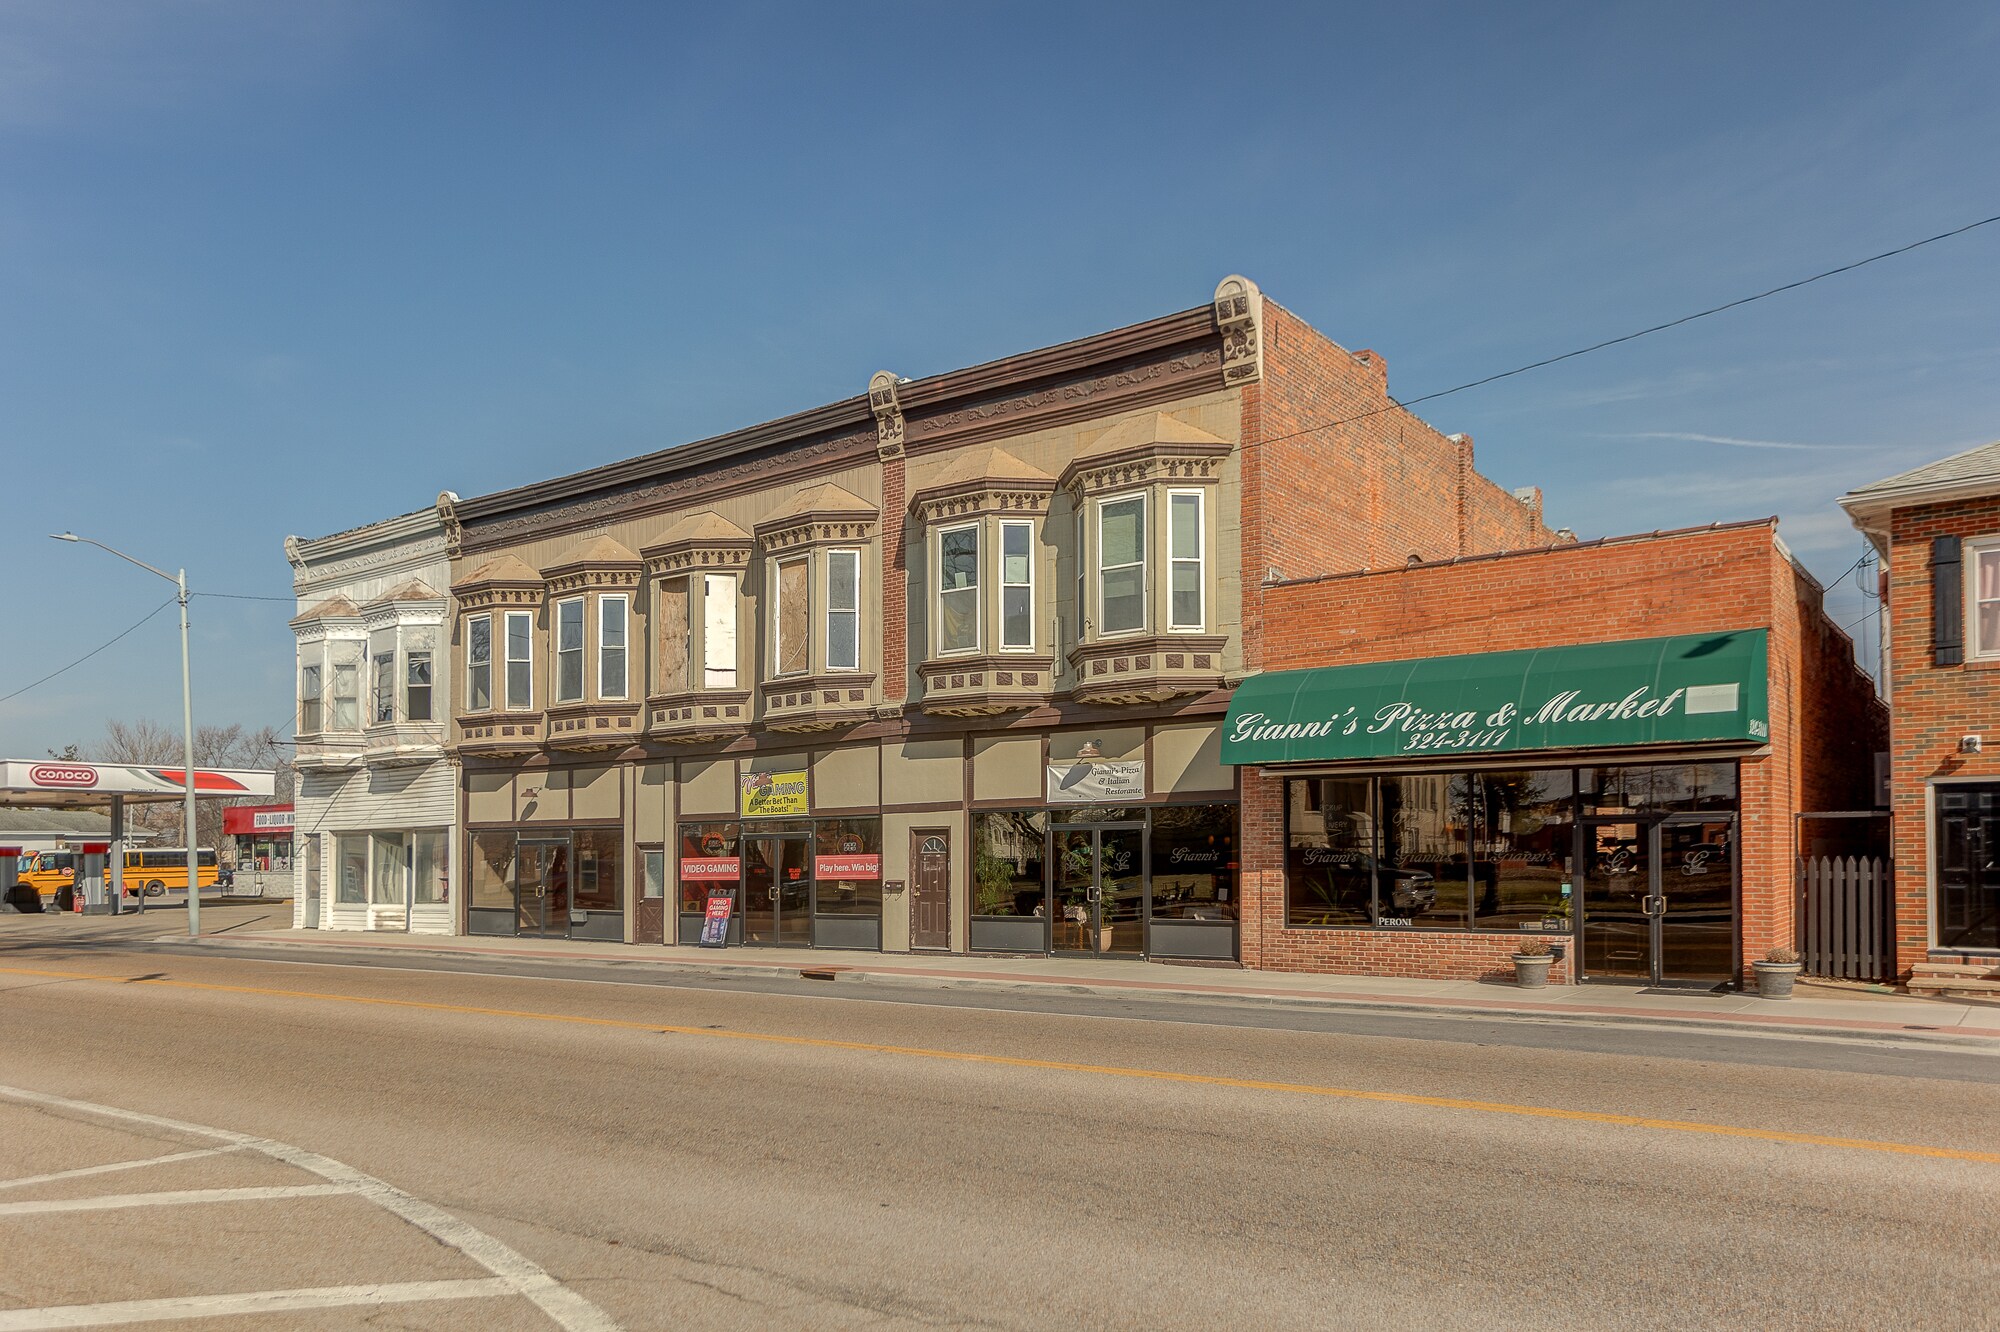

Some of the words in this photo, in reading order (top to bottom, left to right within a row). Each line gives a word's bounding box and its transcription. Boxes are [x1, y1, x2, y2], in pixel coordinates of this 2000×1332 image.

[1229, 706, 1359, 743] Gianni's
[1367, 701, 1478, 734] Pizza
[1485, 702, 1517, 727] &
[1523, 685, 1686, 725] Market
[1403, 728, 1511, 751] 324-3111
[1121, 766, 1140, 774] Pizza
[1107, 777, 1130, 785] Italian
[760, 781, 805, 796] GAMING
[1105, 787, 1142, 795] Restorante
[783, 796, 798, 804] Than
[760, 805, 770, 813] The
[1170, 847, 1220, 864] Gianni's
[1303, 848, 1359, 865] Gianni's
[683, 864, 706, 873] VIDEO
[707, 863, 738, 873] GAMING
[819, 863, 833, 874] Play
[834, 863, 851, 872] here.
[851, 863, 865, 871] Win
[865, 862, 879, 873] big!
